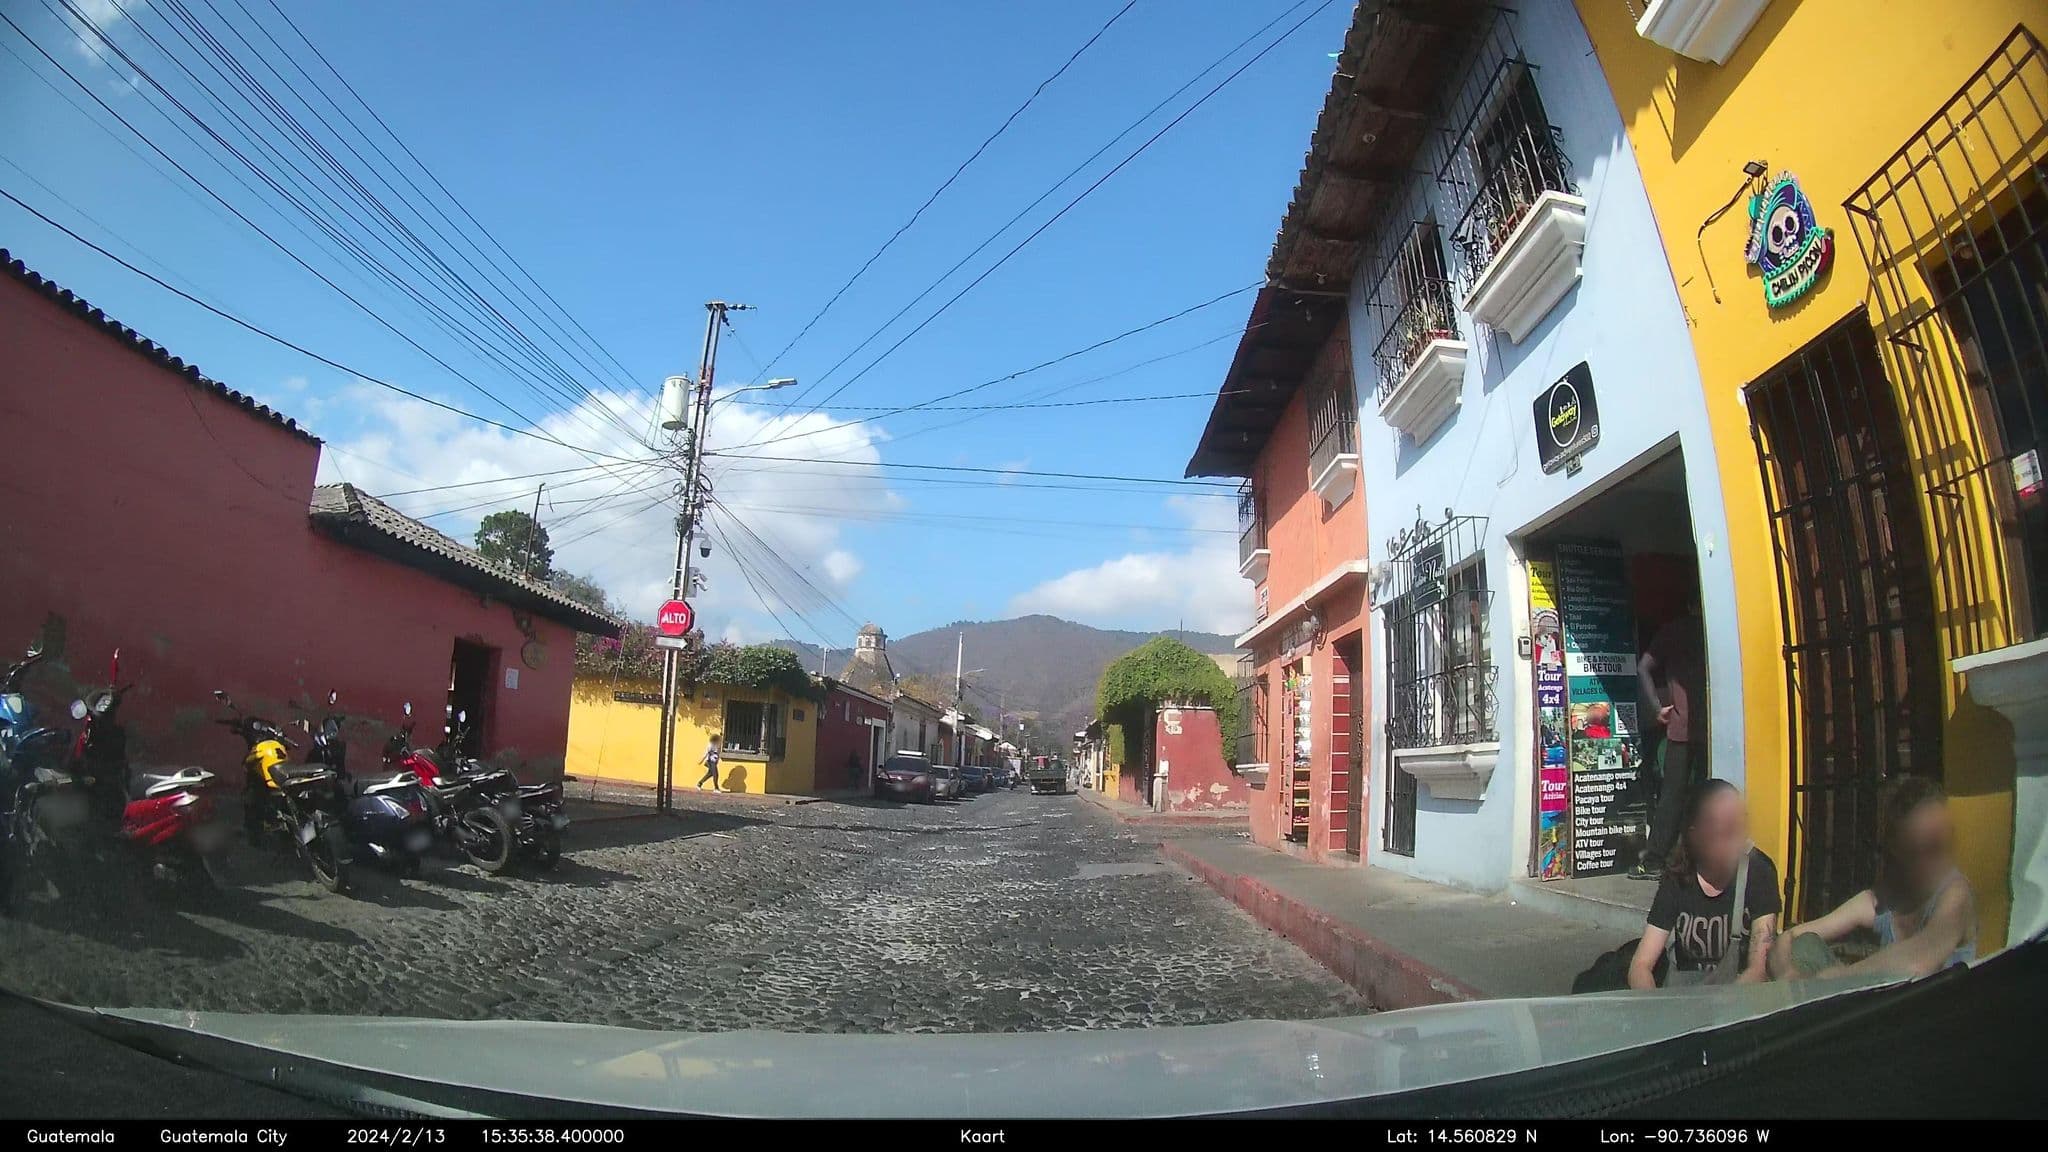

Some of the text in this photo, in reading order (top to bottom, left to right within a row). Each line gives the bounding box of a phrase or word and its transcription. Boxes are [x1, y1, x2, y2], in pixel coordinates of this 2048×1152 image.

[1530, 567, 1551, 578] Tour
[661, 612, 686, 624] ALTO
[1584, 663, 1622, 672] BIKE TOUR
[1538, 669, 1562, 681] Tour
[1542, 693, 1560, 704] 4x4
[1575, 772, 1614, 782] Acatenango
[1541, 779, 1567, 792] Tour
[1575, 784, 1614, 793] Acatenango
[1575, 794, 1614, 805] Pacaya tour
[1575, 806, 1606, 815] Bike tour
[1575, 817, 1604, 828] City tour
[1575, 825, 1636, 837] Mountain bike tour
[1575, 839, 1604, 849] ATV tour
[1575, 849, 1616, 860] Villages tour
[1577, 860, 1614, 871] Coffee tour
